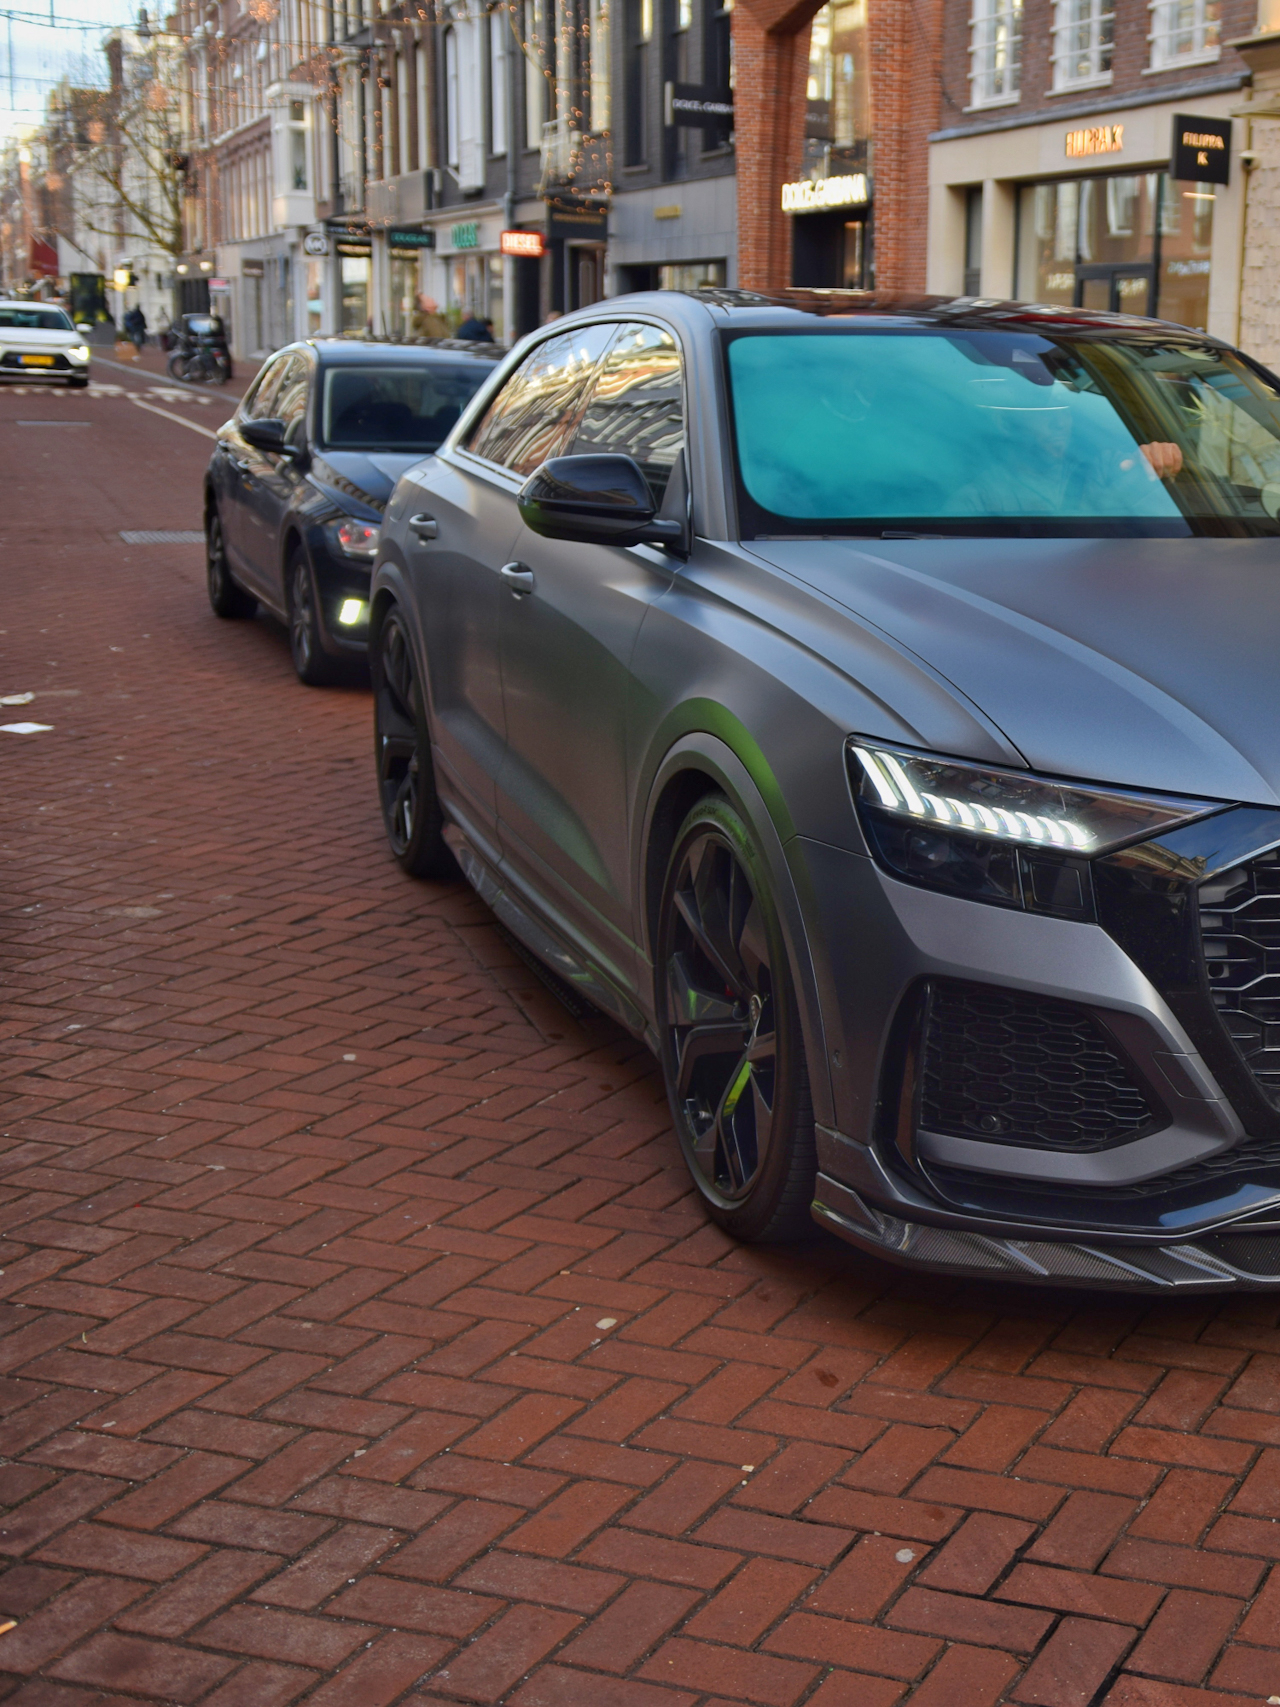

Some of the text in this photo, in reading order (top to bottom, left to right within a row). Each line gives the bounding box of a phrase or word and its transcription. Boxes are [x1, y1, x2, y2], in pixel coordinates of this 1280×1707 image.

[1182, 131, 1225, 149] FILIPPA
[1197, 152, 1209, 166] K
[502, 231, 543, 254] DIESEL
